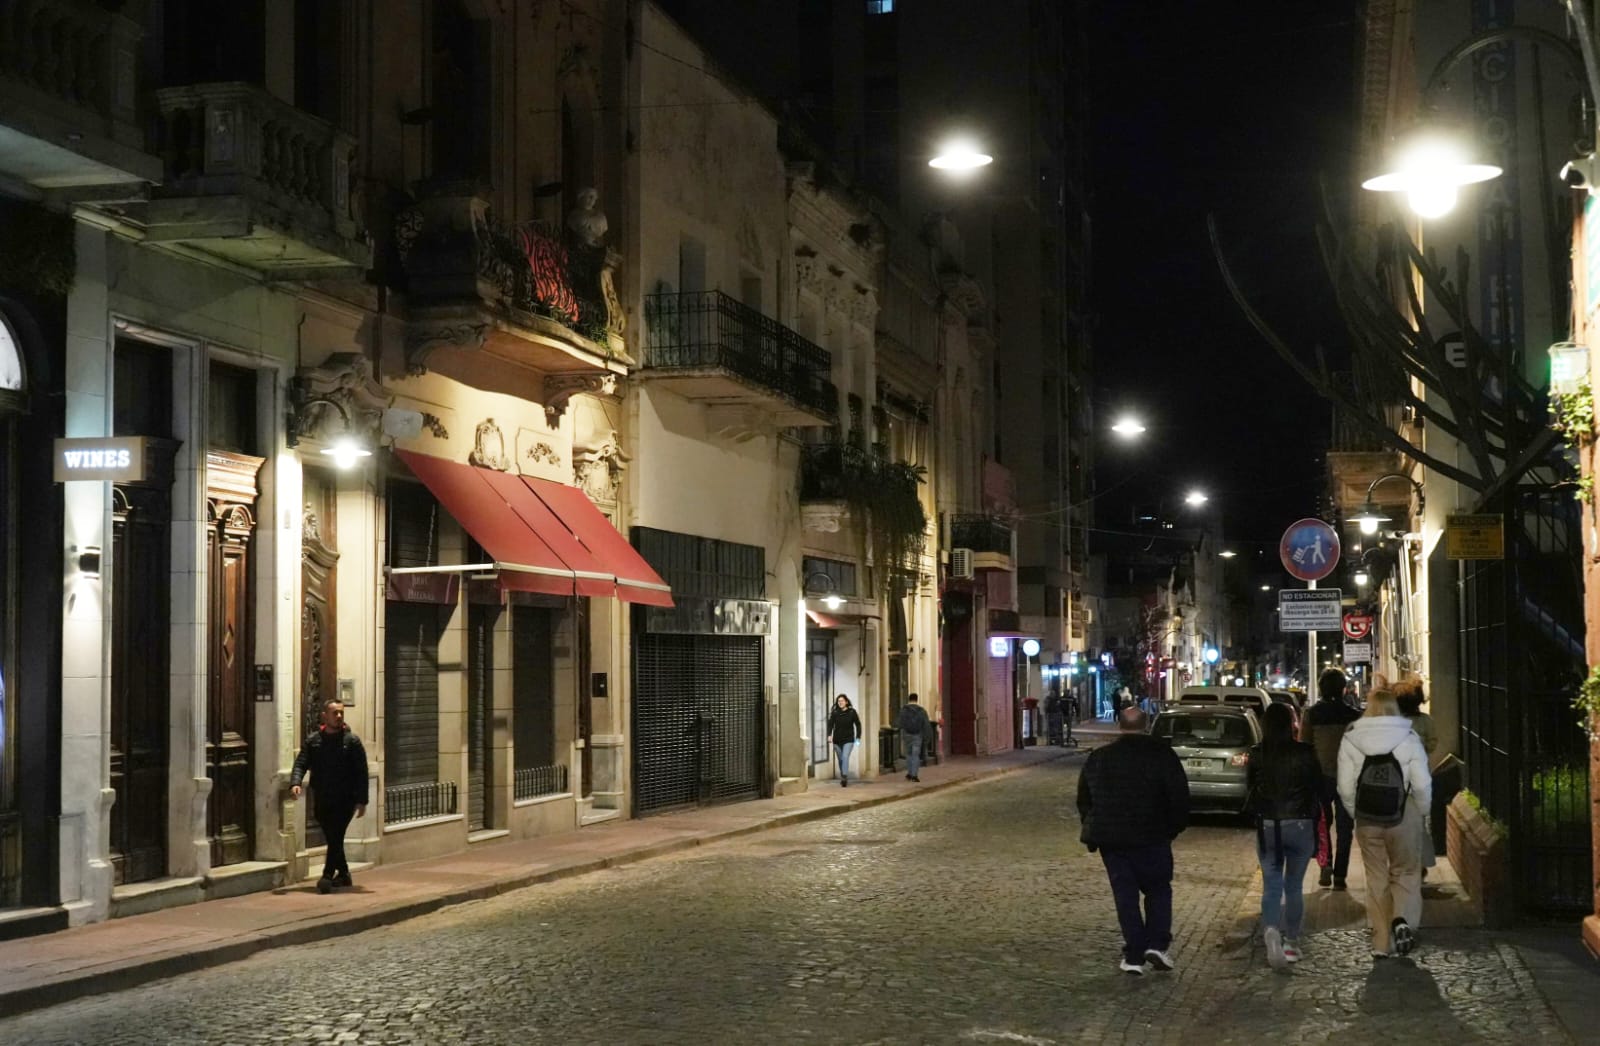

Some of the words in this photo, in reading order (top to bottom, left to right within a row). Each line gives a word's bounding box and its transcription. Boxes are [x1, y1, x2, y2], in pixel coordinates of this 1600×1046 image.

[63, 449, 131, 469] WINES
[1282, 592, 1293, 600] NO
[1294, 592, 1337, 600] ESTACIONAR
